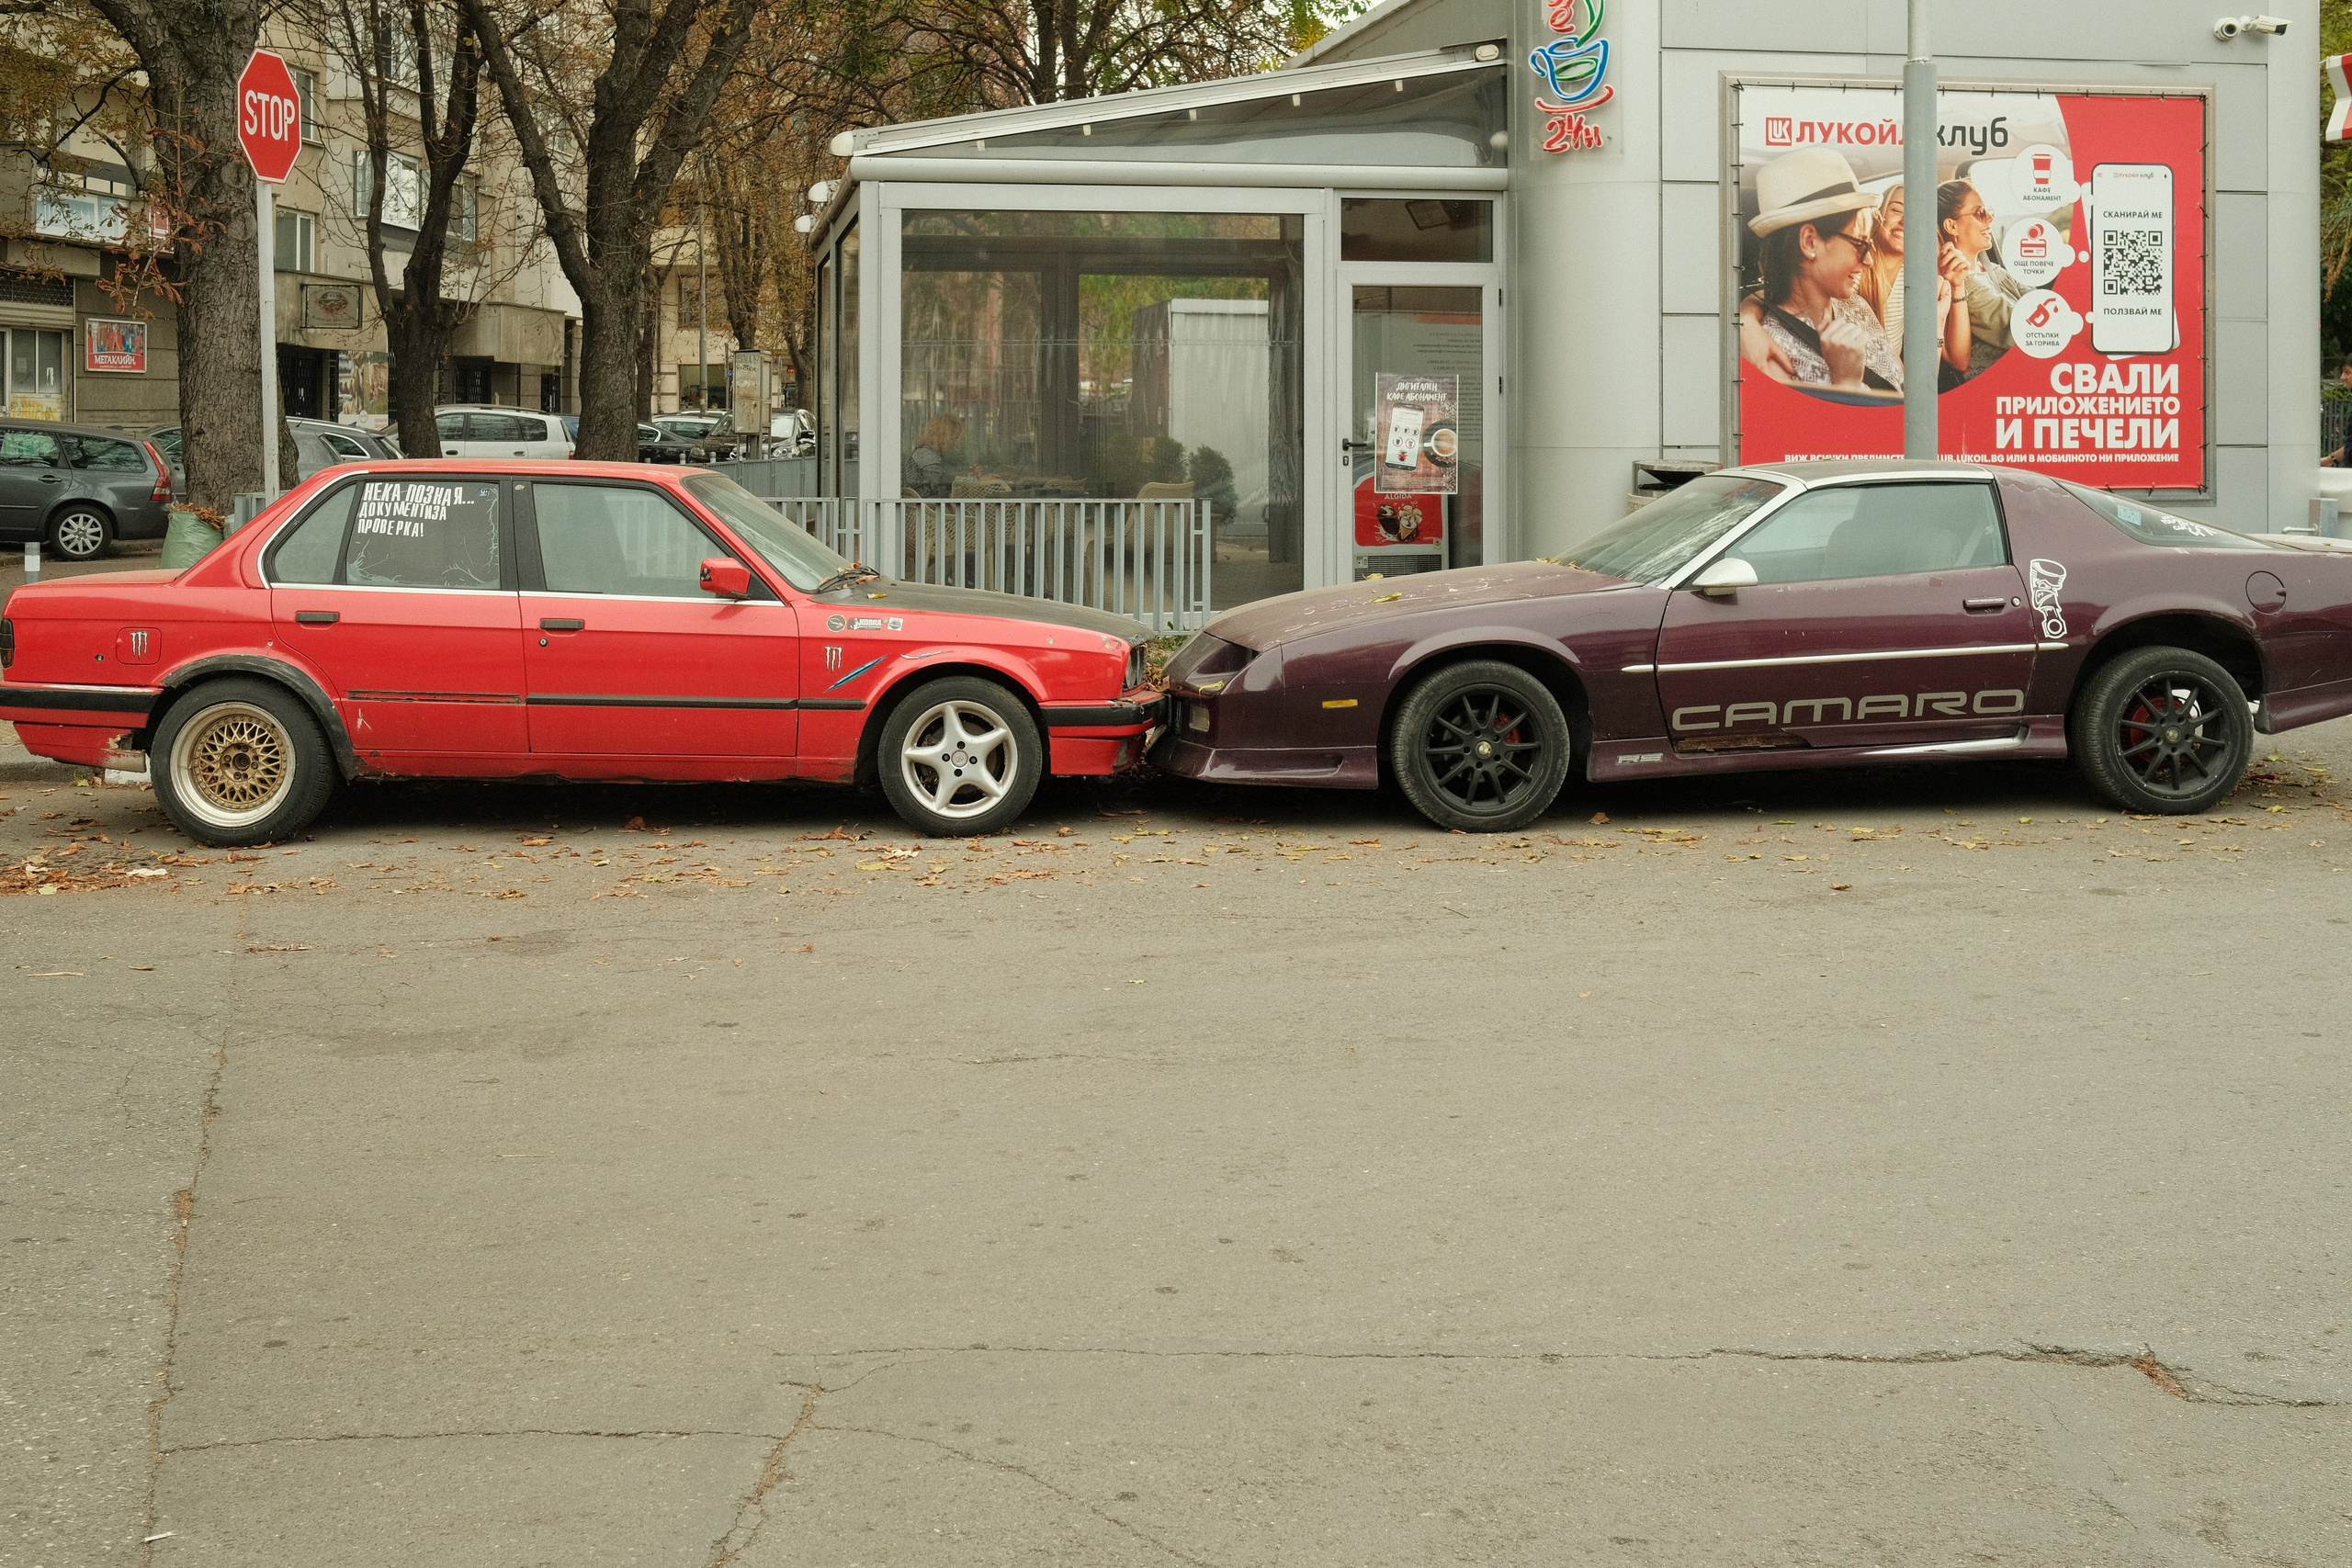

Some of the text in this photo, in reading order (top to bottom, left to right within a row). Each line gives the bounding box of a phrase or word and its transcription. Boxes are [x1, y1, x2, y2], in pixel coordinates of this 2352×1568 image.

[243, 89, 296, 142] STOP
[2102, 210, 2150, 219] СКАНИРАЙ
[2103, 307, 2148, 315] ПОЛЗВАЙ
[2050, 362, 2179, 395] СВАЛИ
[1396, 382, 1438, 392] ДИГИТАЛЕН
[1386, 392, 1448, 401] КАФЕ АБОНАМЕНТ
[1996, 396, 2181, 415] ПРИЛОЖЕНИЕТО
[1996, 418, 2179, 449] И ПЕЧЕЛИ
[2006, 454, 2028, 463] ИЛИ
[2029, 454, 2036, 463] В
[2037, 454, 2098, 463] МОБИЛНОТО
[2098, 454, 2113, 462] НИ
[2114, 453, 2179, 463] ПРИЛОЖЕНИЕ
[363, 482, 475, 506] НЕКА ПОЗНАЯ...
[1384, 492, 1413, 501] ALGIDA
[357, 517, 424, 537] ПРОВЕРКА!
[1671, 688, 2025, 731] CAMARO
[1617, 752, 1664, 763] RS
